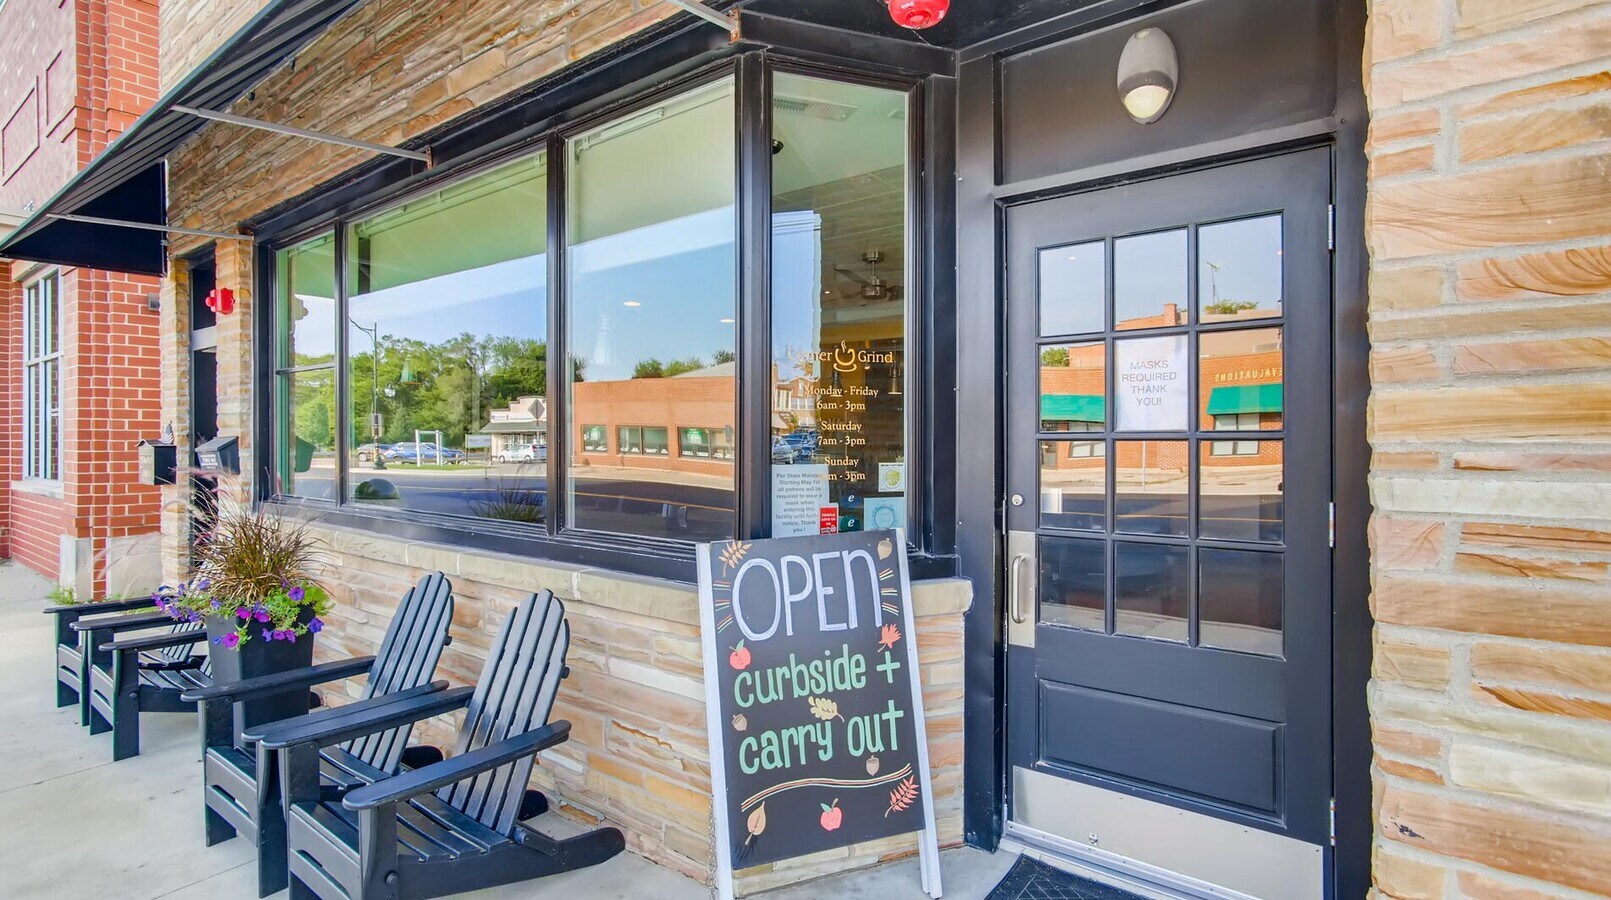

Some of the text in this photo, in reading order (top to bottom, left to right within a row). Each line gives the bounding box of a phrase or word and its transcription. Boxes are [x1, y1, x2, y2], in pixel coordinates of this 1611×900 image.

[858, 351, 893, 363] Grind
[1130, 360, 1168, 370] MASKS
[1121, 372, 1176, 382] REQUIRED
[805, 386, 843, 396] Monday
[850, 386, 879, 397] Friday
[1130, 385, 1167, 394] THANK
[817, 401, 837, 410] 6am
[845, 400, 865, 412] 3pm
[1135, 397, 1162, 406] YOU!
[821, 421, 862, 432] Saturday
[818, 436, 837, 445] 7am
[845, 436, 865, 447] 3pm
[824, 456, 859, 467] Sunday
[845, 471, 866, 483] 3pm
[734, 643, 866, 708] curbside
[739, 700, 905, 775] carry out
